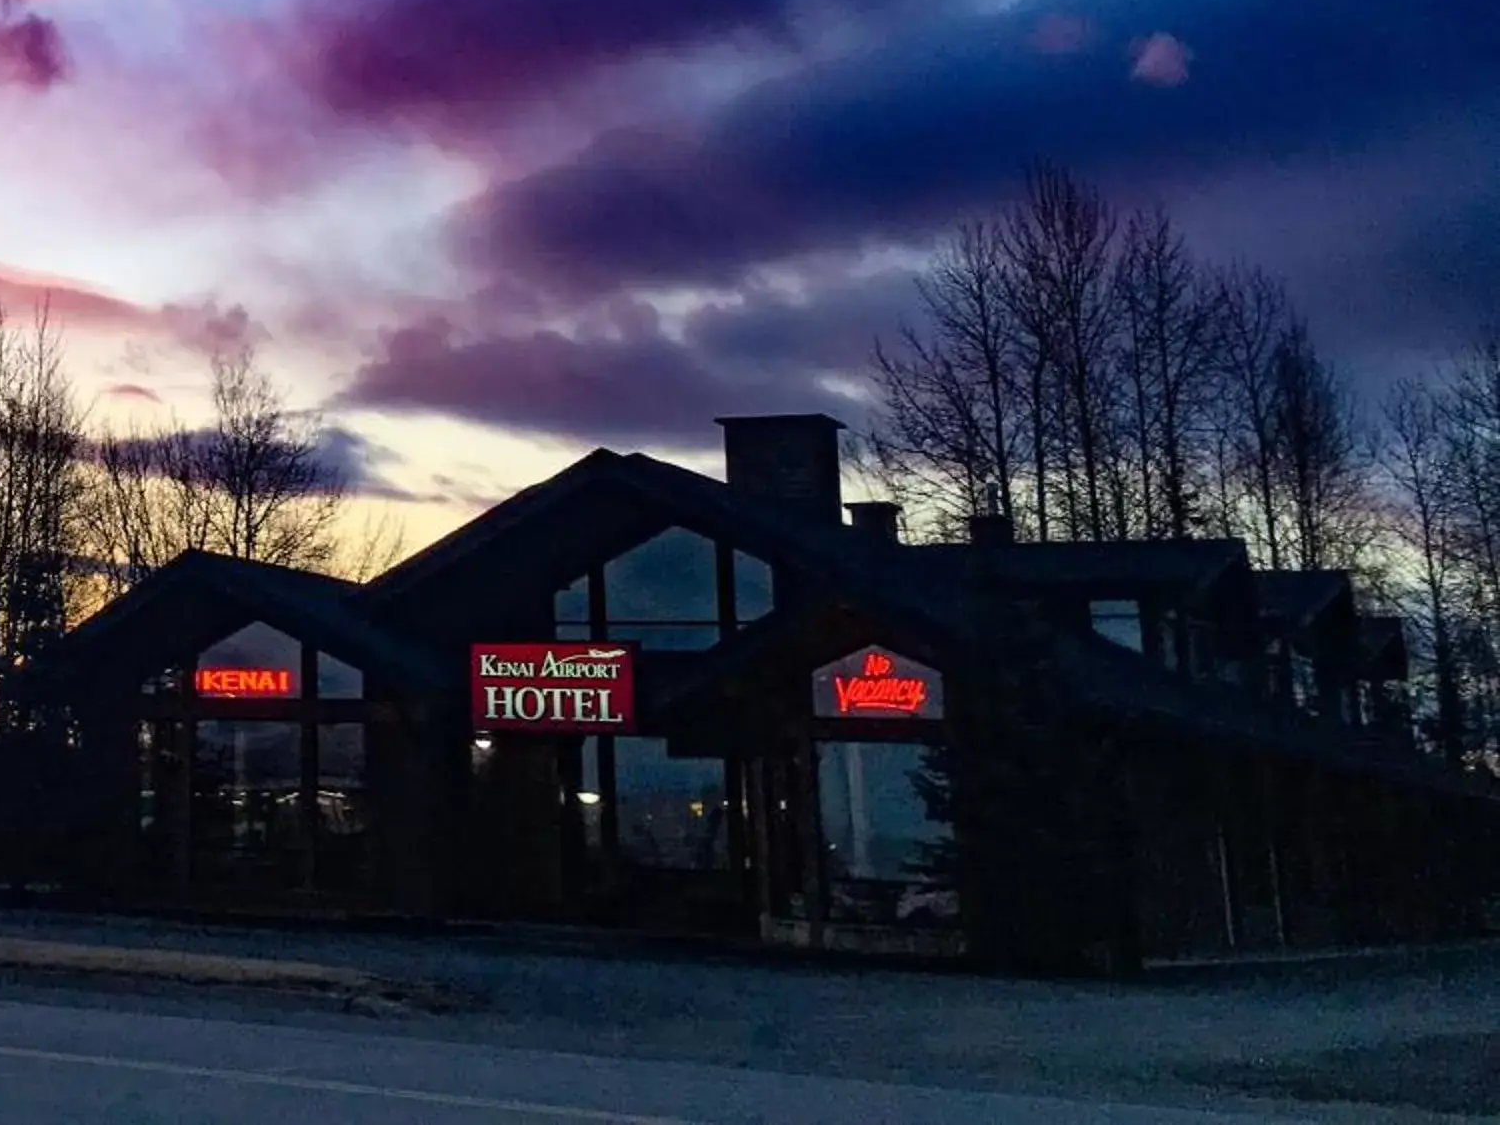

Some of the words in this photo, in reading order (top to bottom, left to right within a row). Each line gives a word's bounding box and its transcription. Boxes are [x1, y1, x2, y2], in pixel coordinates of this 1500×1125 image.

[202, 670, 289, 691] KENAI
[540, 650, 621, 679] AIRPORT
[484, 686, 623, 723] HOTEL
[835, 676, 926, 712] Vacancy
